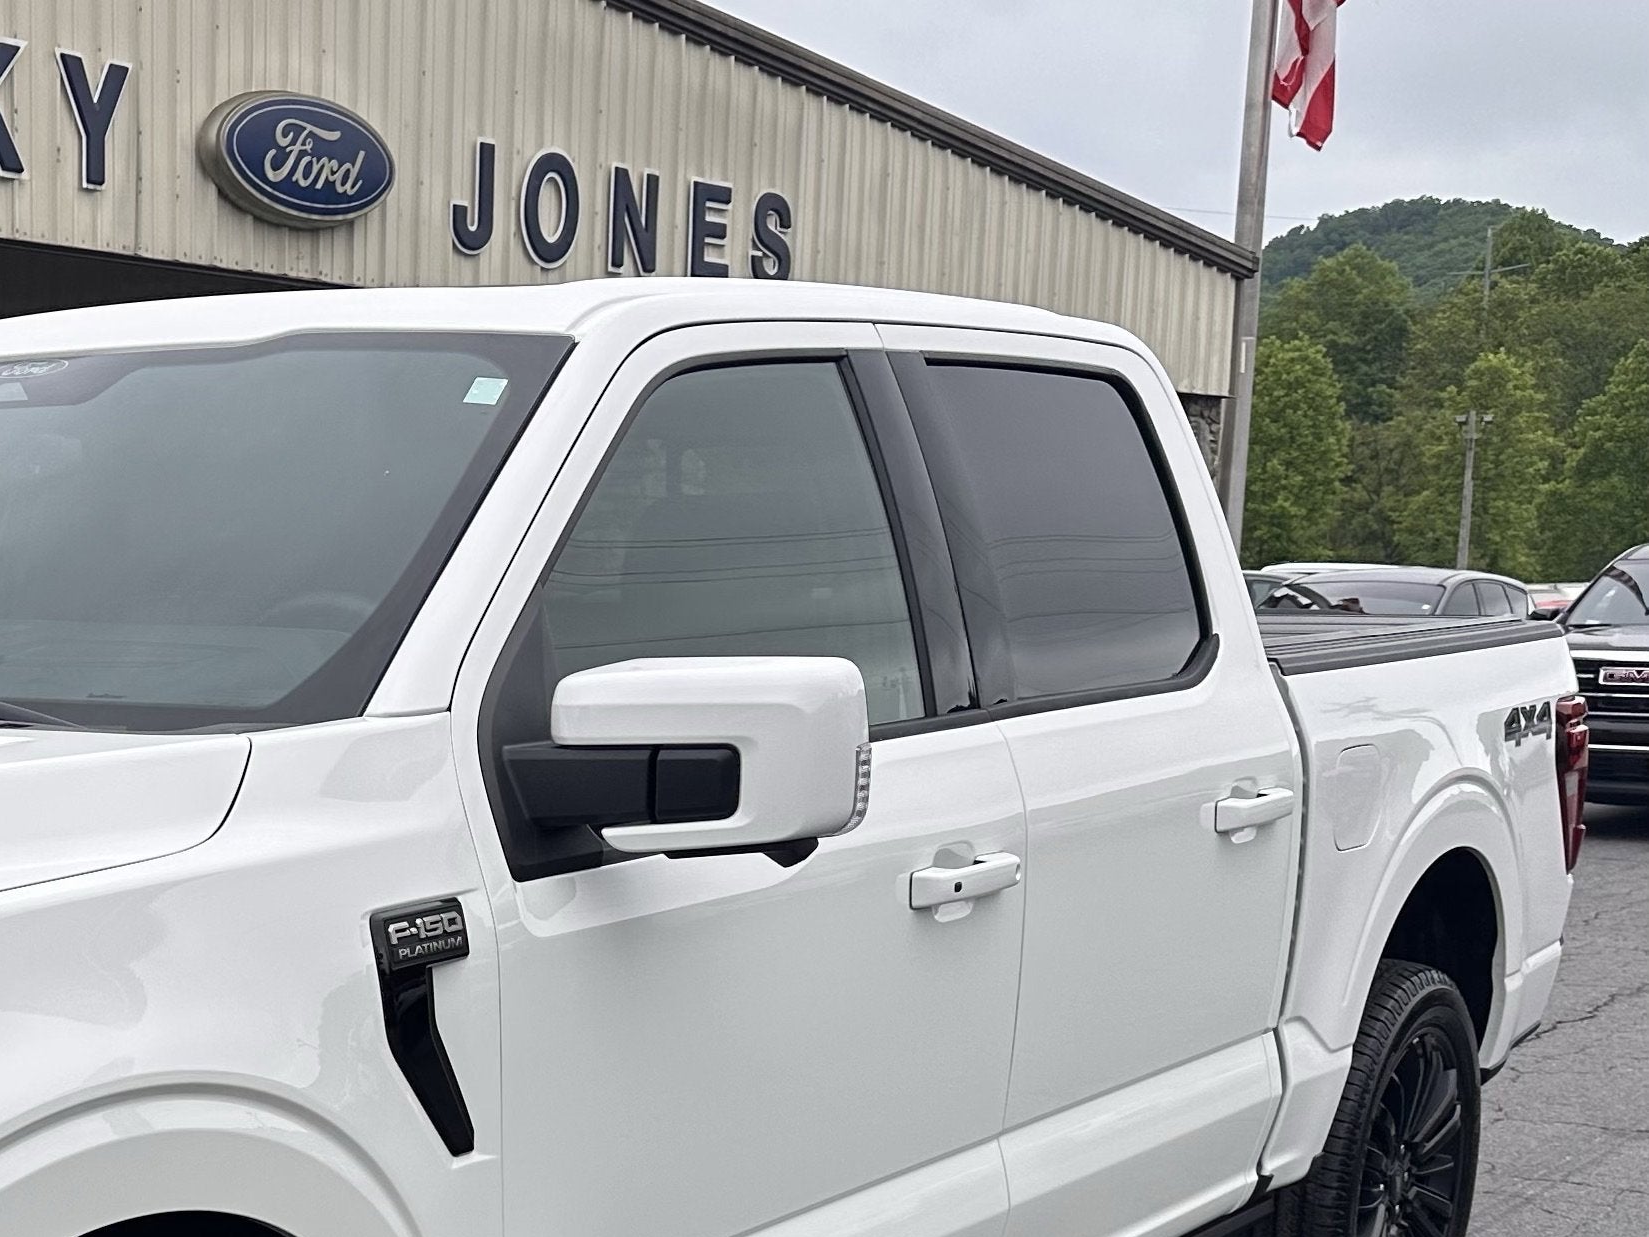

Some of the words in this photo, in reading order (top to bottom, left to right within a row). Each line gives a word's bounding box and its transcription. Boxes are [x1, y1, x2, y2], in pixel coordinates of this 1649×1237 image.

[264, 118, 365, 196] Ford
[452, 136, 792, 280] JONES
[388, 911, 463, 944] F-150
[398, 936, 463, 959] PLATINUM
